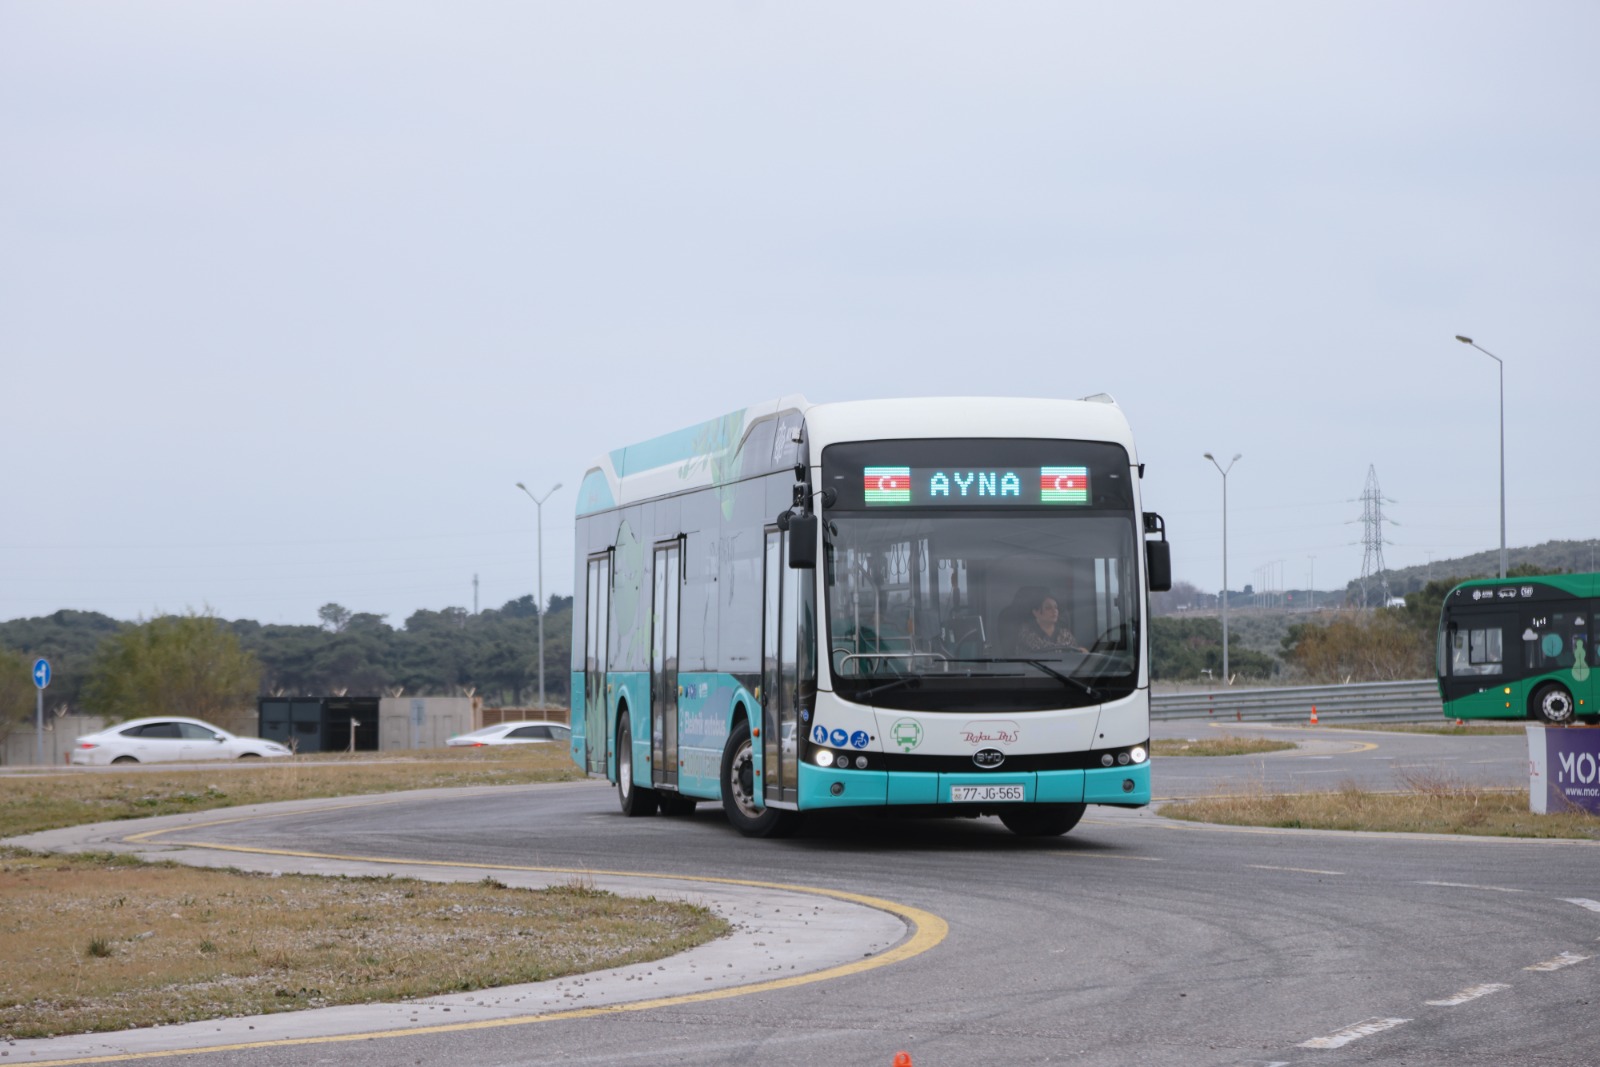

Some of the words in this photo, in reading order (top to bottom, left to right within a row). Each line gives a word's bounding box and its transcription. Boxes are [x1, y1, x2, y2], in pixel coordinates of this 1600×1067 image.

[930, 471, 1020, 496] AYNA
[976, 752, 1002, 763] BYD
[1558, 751, 1600, 785] MO
